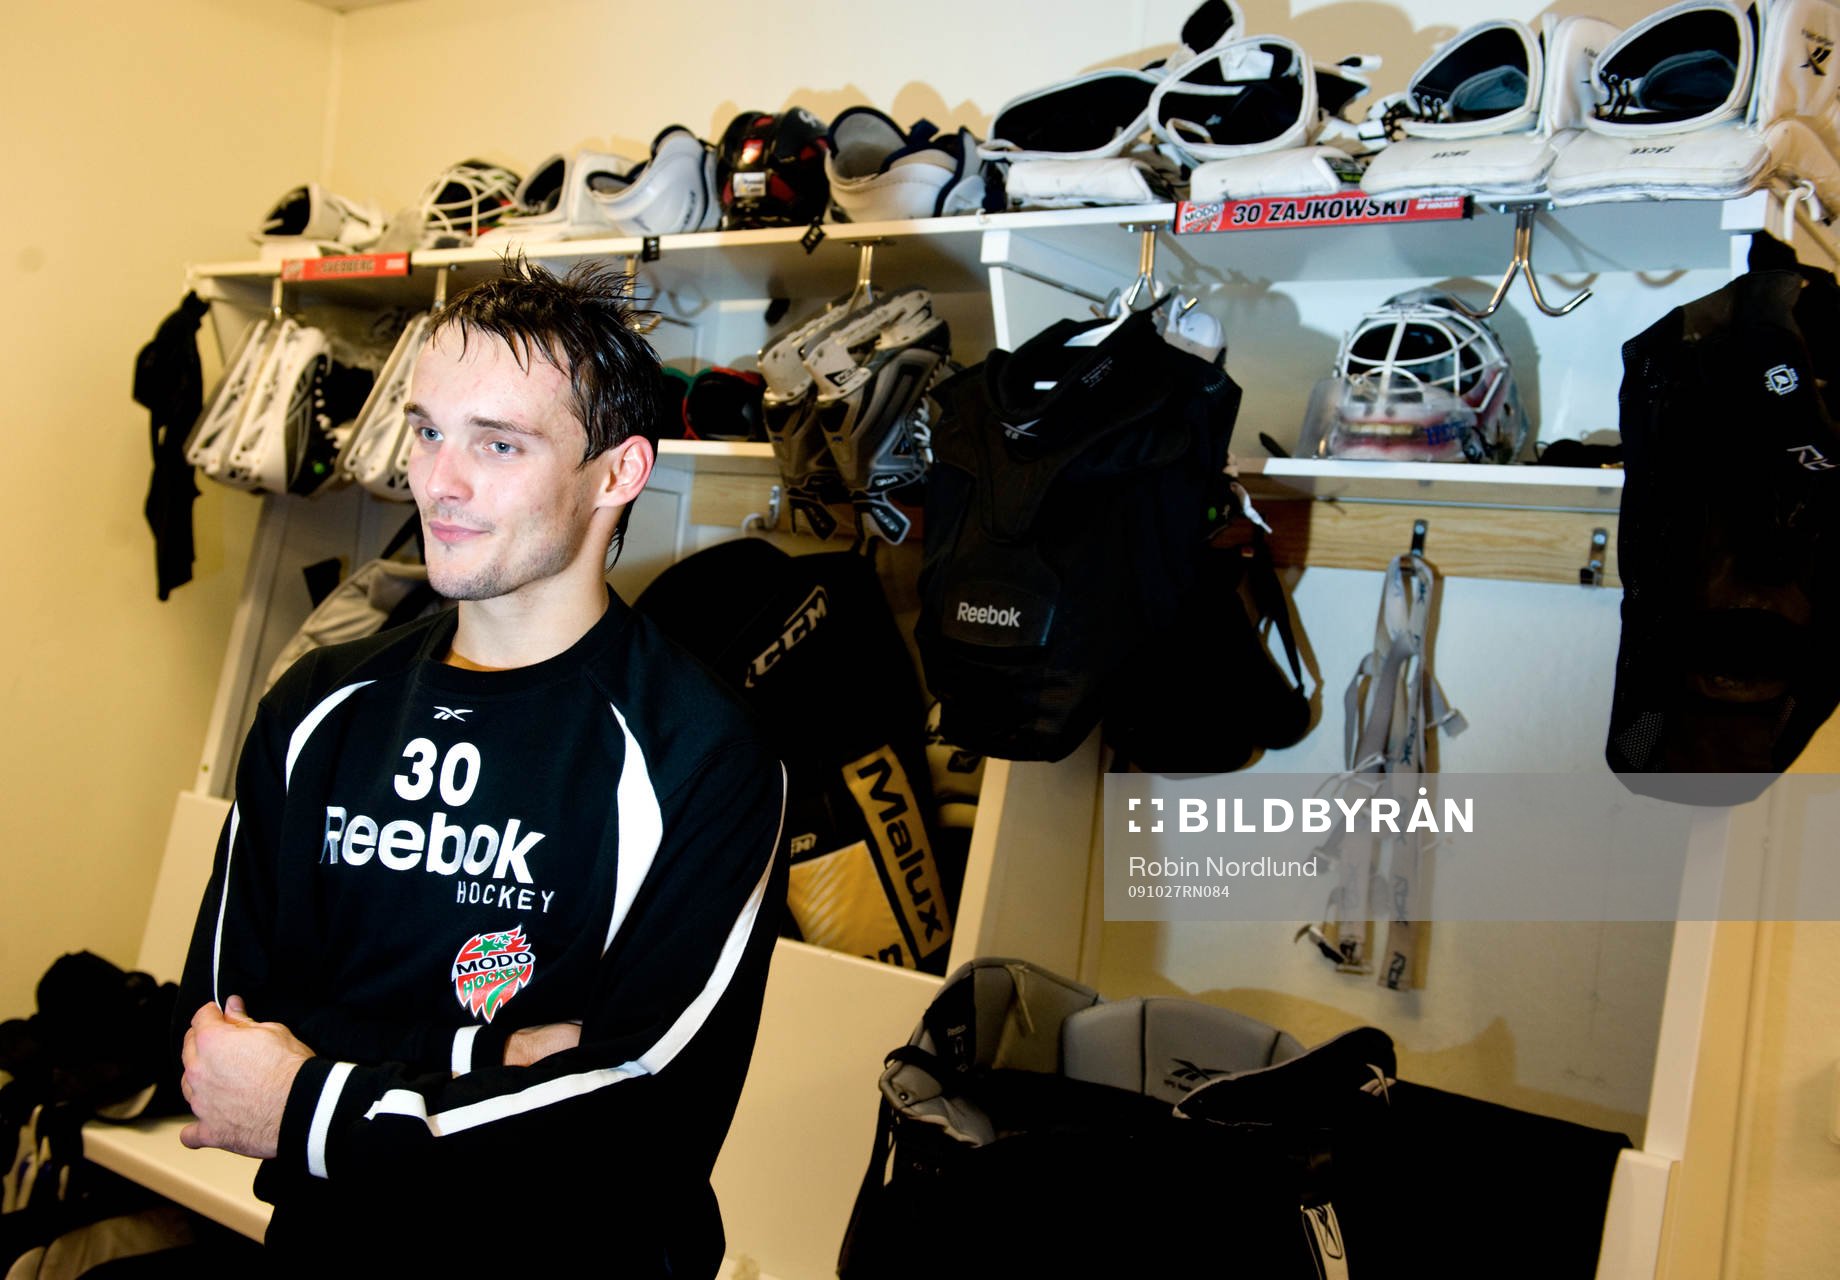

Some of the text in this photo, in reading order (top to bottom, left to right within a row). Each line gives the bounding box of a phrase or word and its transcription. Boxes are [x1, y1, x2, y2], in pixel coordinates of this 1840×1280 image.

[1232, 204, 1263, 224] 30
[1267, 197, 1409, 222] ZAJKOWSKI
[957, 601, 1021, 628] Reebok
[748, 593, 828, 680] CCM
[394, 737, 481, 806] 30
[320, 805, 546, 884] Reebok
[857, 757, 943, 942] Malux
[456, 881, 555, 913] HOCKEY
[456, 952, 532, 975] MODO
[462, 965, 526, 997] HOCKEY
